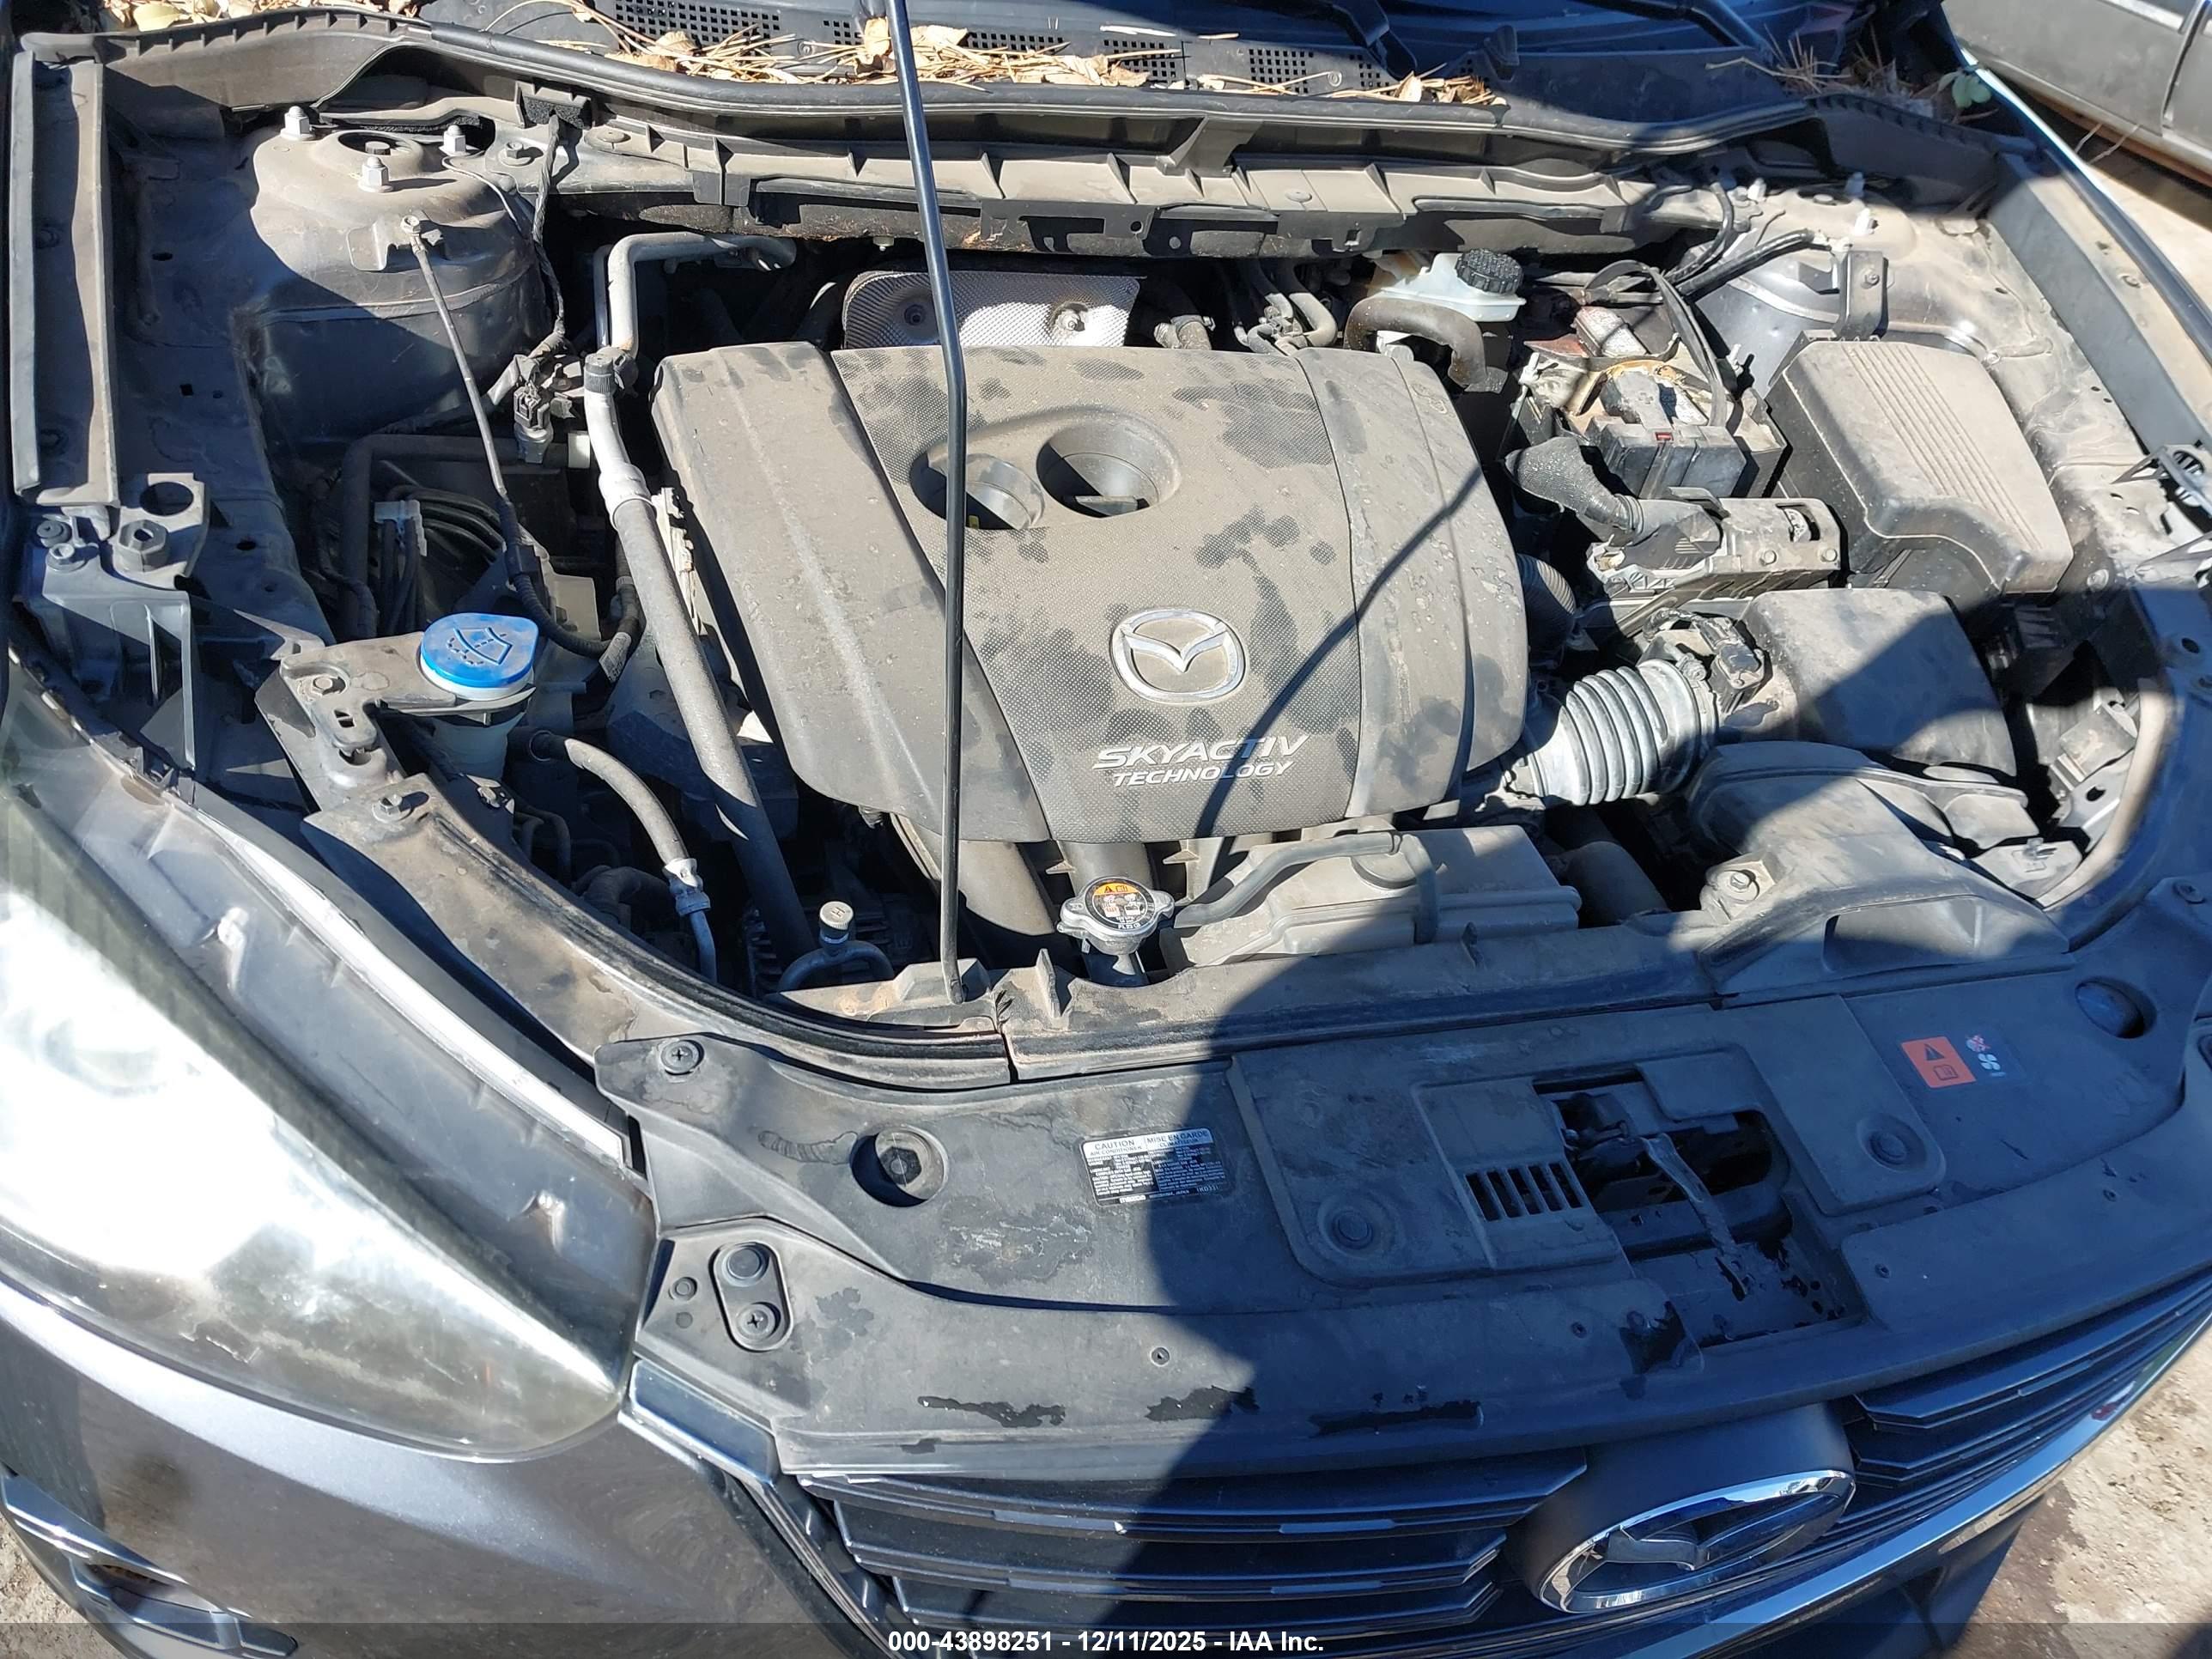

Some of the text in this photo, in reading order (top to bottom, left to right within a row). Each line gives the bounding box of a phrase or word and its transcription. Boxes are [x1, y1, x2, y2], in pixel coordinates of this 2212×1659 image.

[1092, 734, 1311, 769] SKYACTIV
[1114, 760, 1295, 787] TECHNOLOGY
[1180, 1130, 1208, 1139] GARDE
[1094, 1139, 1135, 1151] CAUTION
